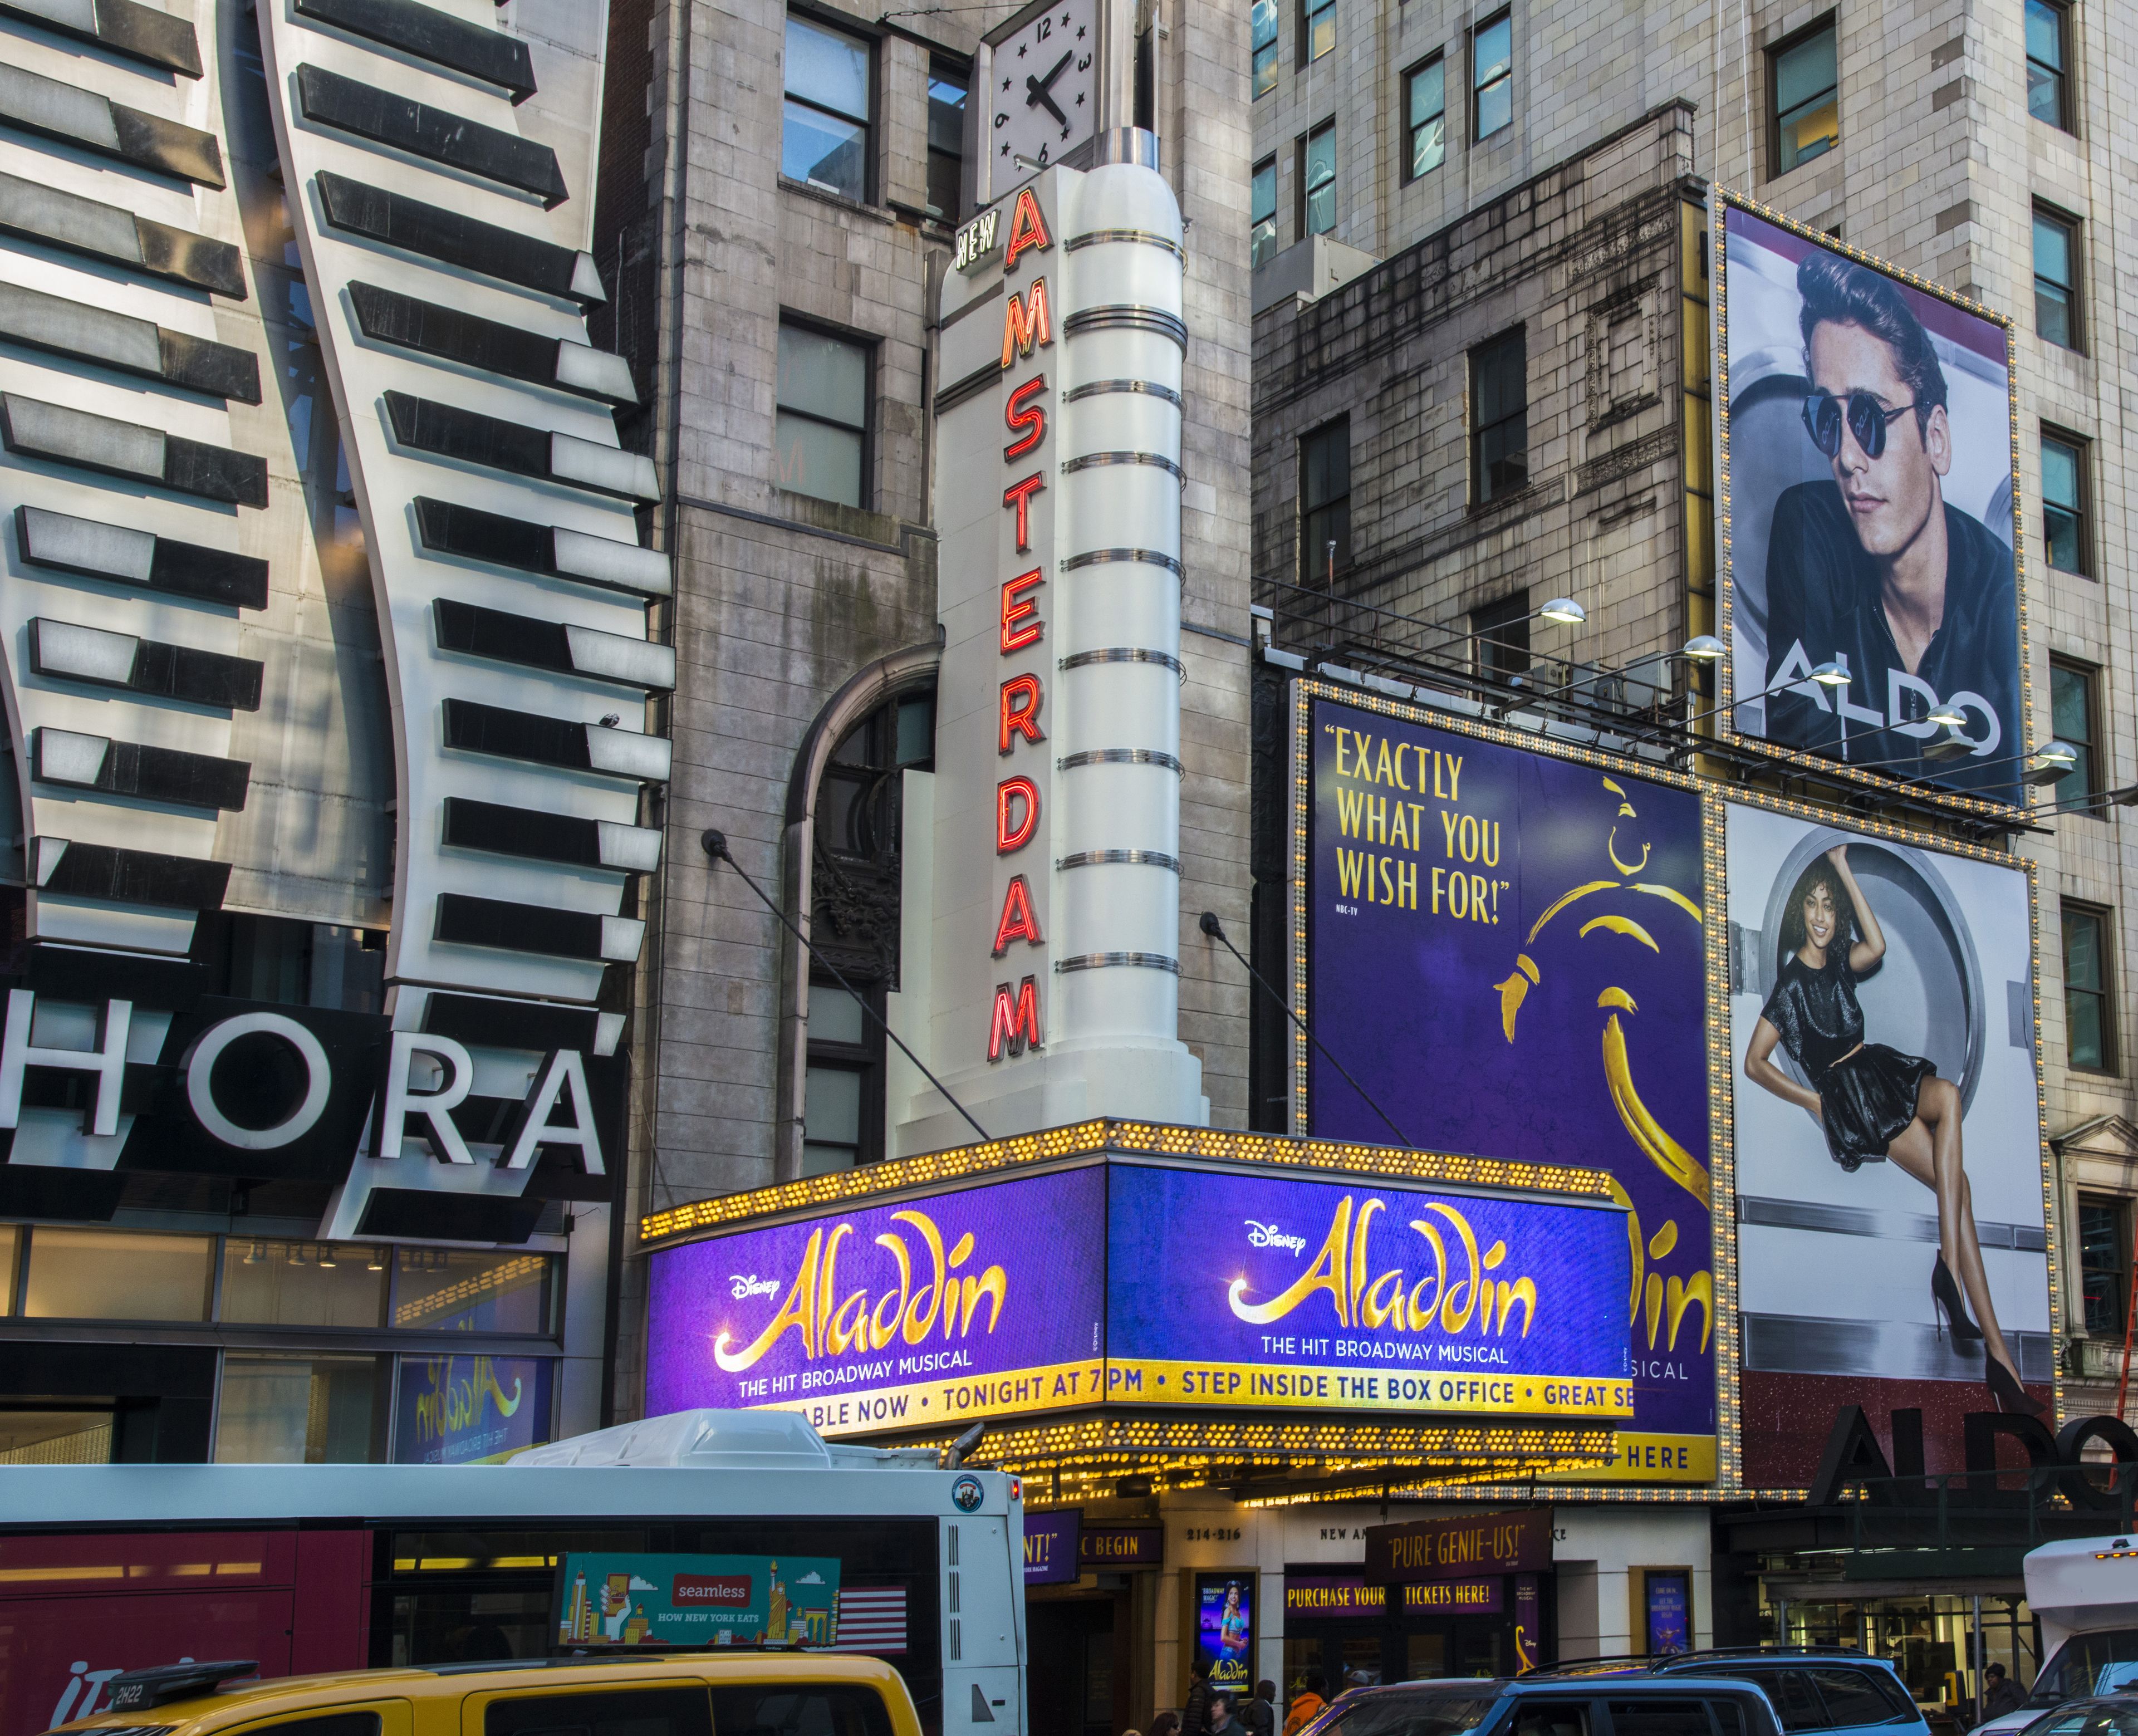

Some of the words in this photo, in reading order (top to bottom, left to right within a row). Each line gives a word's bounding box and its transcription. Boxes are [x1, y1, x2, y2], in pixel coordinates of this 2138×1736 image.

[1037, 17, 1051, 43] 12
[1078, 53, 1092, 72] 3
[956, 210, 997, 271] NEW
[987, 185, 1055, 1064] AMSTERDAM
[1766, 638, 2001, 757] ALDO
[1325, 724, 1463, 801] “EXACTLY
[1337, 787, 1425, 851] WHAT
[1441, 810, 1499, 867] YOU
[1336, 847, 1417, 910] WISH
[1432, 867, 1509, 925] FOR!”
[1336, 904, 1358, 916] NBC-TV
[0, 989, 606, 1175] HORA
[1244, 1220, 1306, 1257] Disney
[1229, 1195, 1537, 1338] Aladdin
[714, 1209, 1007, 1373] Aladdin
[729, 1274, 781, 1301] Disney
[1261, 1336, 1296, 1355] THE
[1302, 1338, 1329, 1356] HIT
[1336, 1340, 1433, 1360] BROADWAY
[1438, 1343, 1508, 1364] MUSICAL
[739, 1380, 767, 1398] THE
[772, 1375, 797, 1393] HIT
[802, 1360, 893, 1390] BROADWAY
[899, 1349, 973, 1375] MUSICAL
[858, 1395, 909, 1421] NOW
[944, 1376, 1043, 1411] TONIGHT
[1052, 1372, 1080, 1398] AT
[1182, 1371, 1241, 1394] STEP
[1251, 1373, 1328, 1397] INSIDE
[1337, 1376, 1379, 1400] THE
[1388, 1377, 1430, 1401] BOX
[1440, 1380, 1514, 1403] OFFICE
[1544, 1384, 1606, 1406] GREAT
[1628, 1445, 1688, 1469] HERE
[1804, 1404, 2138, 1511] ALDO
[1096, 1536, 1138, 1556] BEGIN
[1321, 1528, 1346, 1540] NEW
[1388, 1533, 1432, 1569] “PURE
[1438, 1523, 1526, 1564] GENIE-US!”
[679, 1584, 746, 1598] seamless
[1288, 1587, 1350, 1608] PURCHASE
[1354, 1586, 1386, 1606] YOUR
[1404, 1586, 1451, 1605] TICKETS
[1456, 1585, 1489, 1603] HERE!
[658, 1614, 683, 1622] HOW
[685, 1614, 709, 1622] NEW
[709, 1614, 735, 1622] YORK
[737, 1614, 759, 1623] EATS
[1208, 1659, 1248, 1680] Aladdin
[116, 1684, 144, 1705] 2H22
